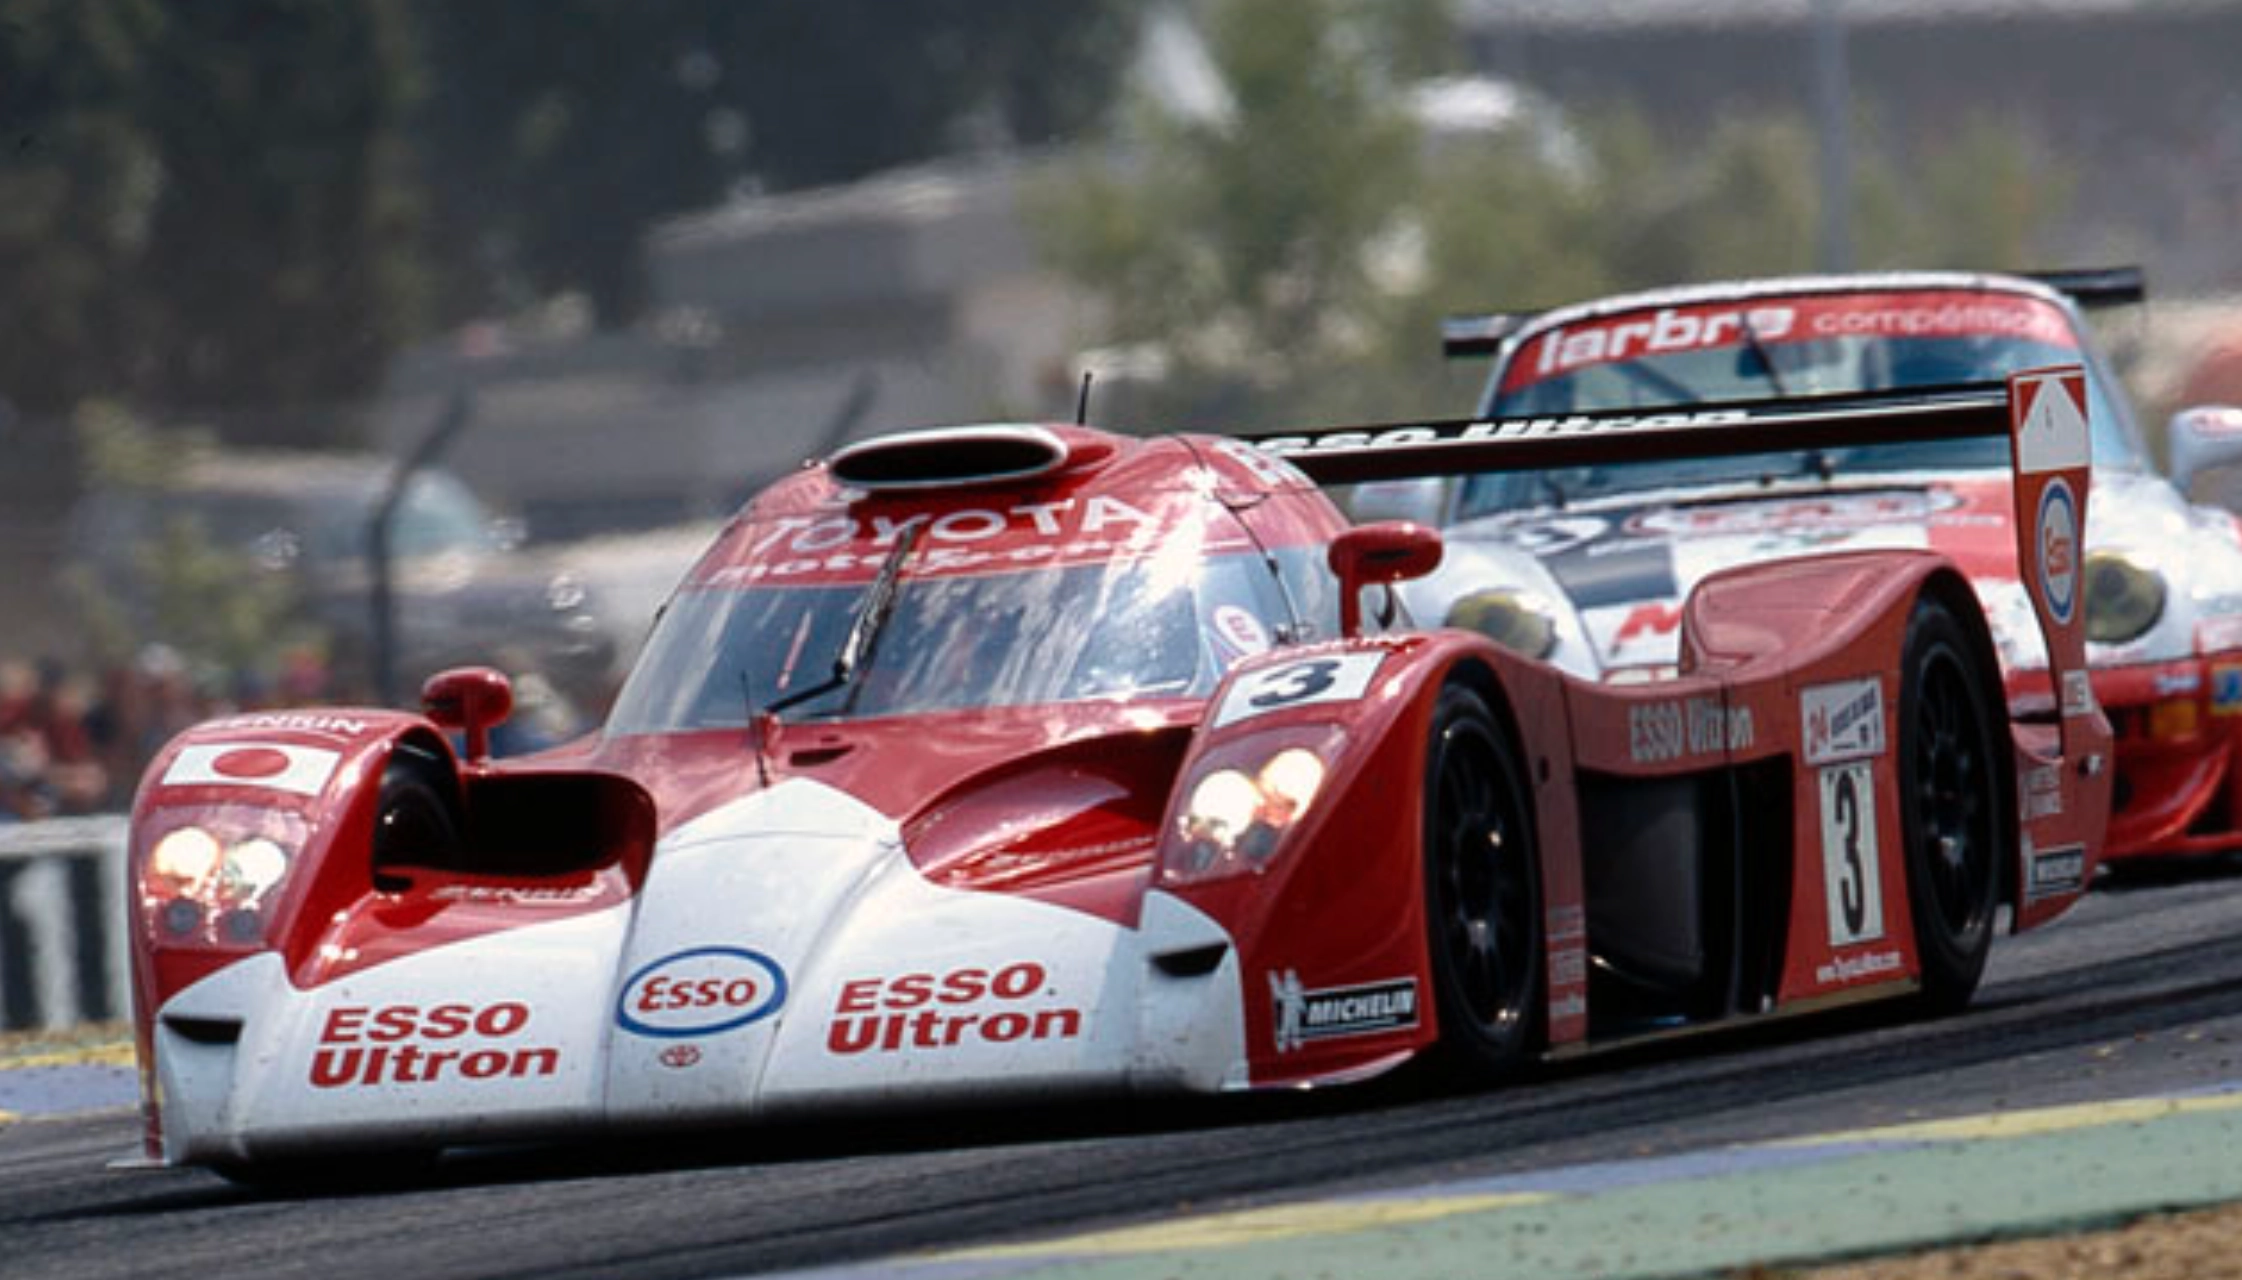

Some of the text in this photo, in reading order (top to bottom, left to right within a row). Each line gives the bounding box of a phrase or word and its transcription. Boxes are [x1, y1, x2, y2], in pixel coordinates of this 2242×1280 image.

[750, 496, 1158, 556] TOYOTA
[1249, 659, 1341, 706] 3
[1629, 701, 1683, 763] ESSO
[1834, 767, 1866, 937] 3
[834, 961, 1047, 1014] ESSO
[1307, 990, 1415, 1027] MICHELIN
[320, 1001, 530, 1043] ESSO
[827, 1007, 1081, 1055] Ultron
[309, 1044, 560, 1088] Ultron
